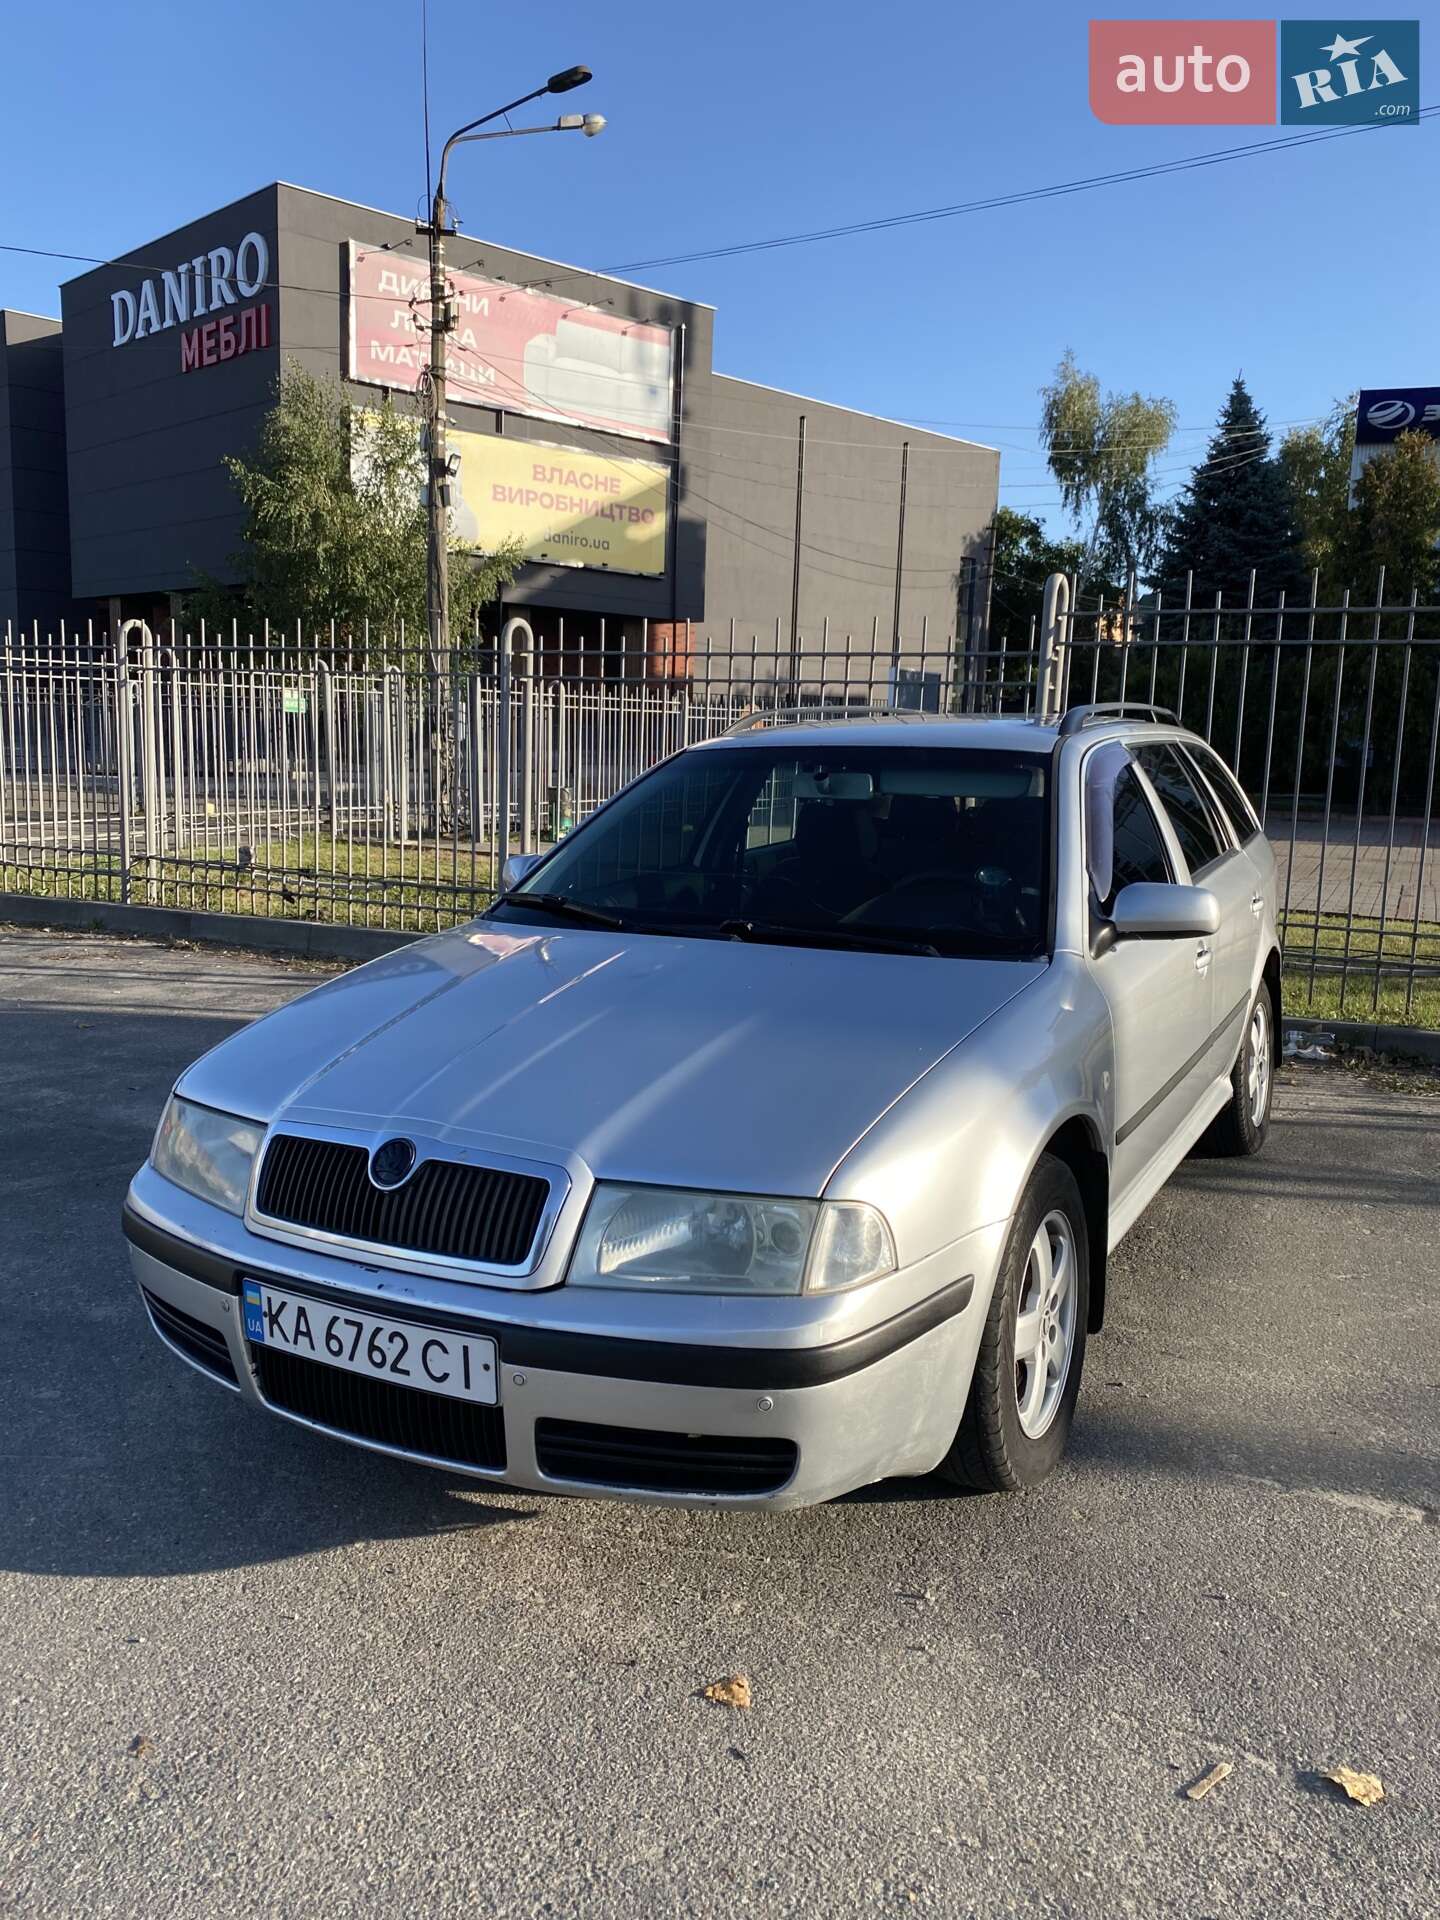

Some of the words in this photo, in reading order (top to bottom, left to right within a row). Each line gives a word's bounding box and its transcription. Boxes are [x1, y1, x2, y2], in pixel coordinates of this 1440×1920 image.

[110, 231, 269, 348] DANIRO
[180, 303, 271, 373] МЕБЛІ
[491, 484, 655, 525] ВИРОБНИЦТВО
[532, 463, 622, 497] ВЛАСНЕ
[248, 1319, 263, 1335] UA
[266, 1296, 316, 1352] KA
[325, 1315, 411, 1377] 6762
